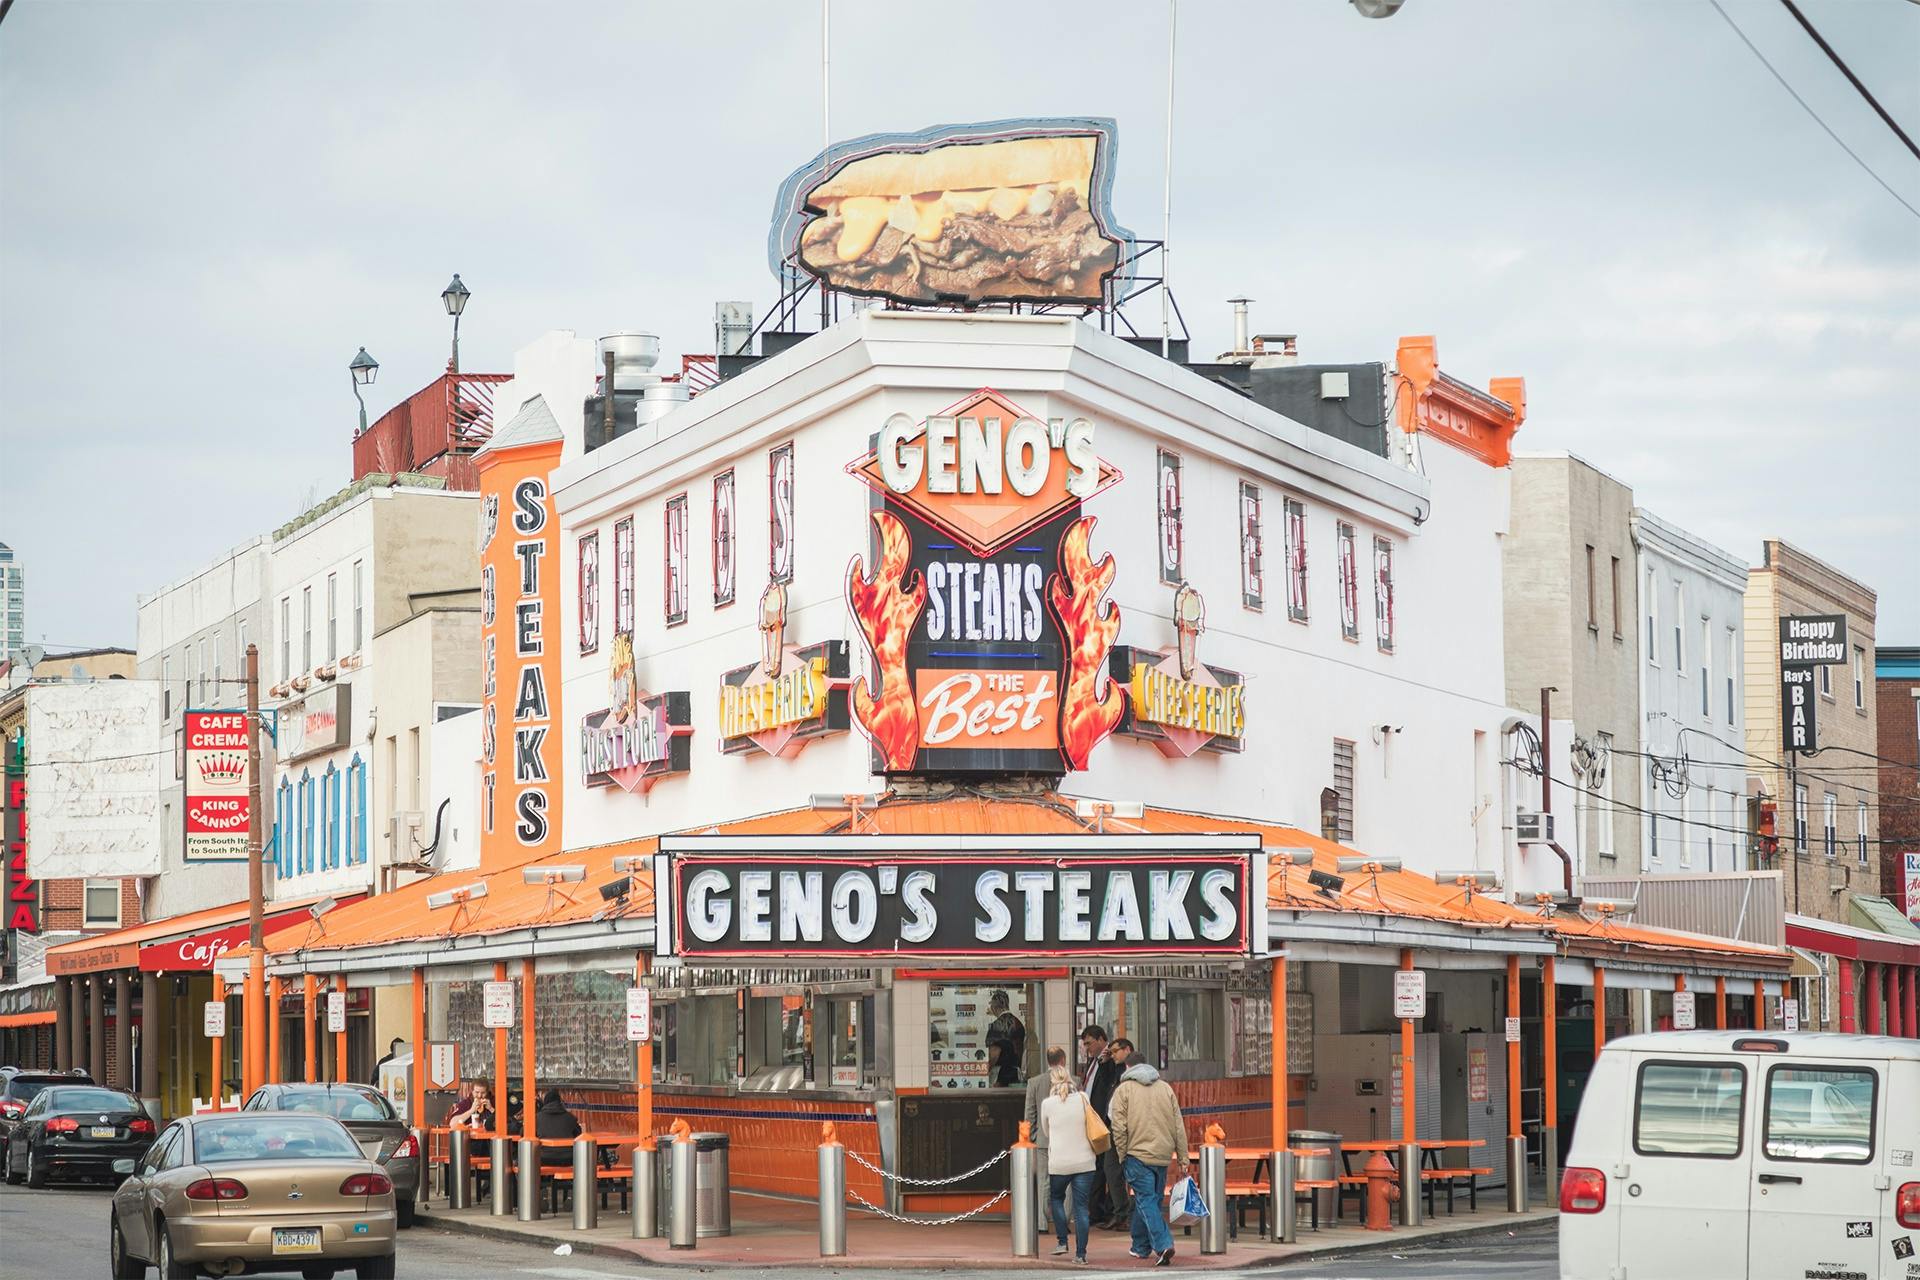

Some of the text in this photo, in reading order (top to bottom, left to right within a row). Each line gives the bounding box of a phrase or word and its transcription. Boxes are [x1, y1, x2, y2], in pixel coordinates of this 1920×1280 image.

[878, 412, 1100, 499] GENO'S
[926, 560, 1044, 643] STEAKS
[1789, 619, 1836, 639] Happy
[1782, 641, 1845, 661] Birthday
[512, 477, 550, 847] STEAKS
[985, 673, 1025, 692] THE
[1783, 669, 1812, 684] Ray's
[920, 671, 1055, 746] Best
[1136, 663, 1247, 739] CHEESE FRIES
[199, 716, 243, 729] CAFE
[1791, 685, 1807, 747] BAR
[192, 733, 249, 747] CREMA
[202, 801, 240, 811] KING
[188, 837, 249, 845] From South Ita
[190, 846, 249, 855] to South Phil
[686, 865, 1236, 943] GENO'S STEAKS
[179, 938, 228, 967] Café
[963, 1063, 988, 1071] GEAR
